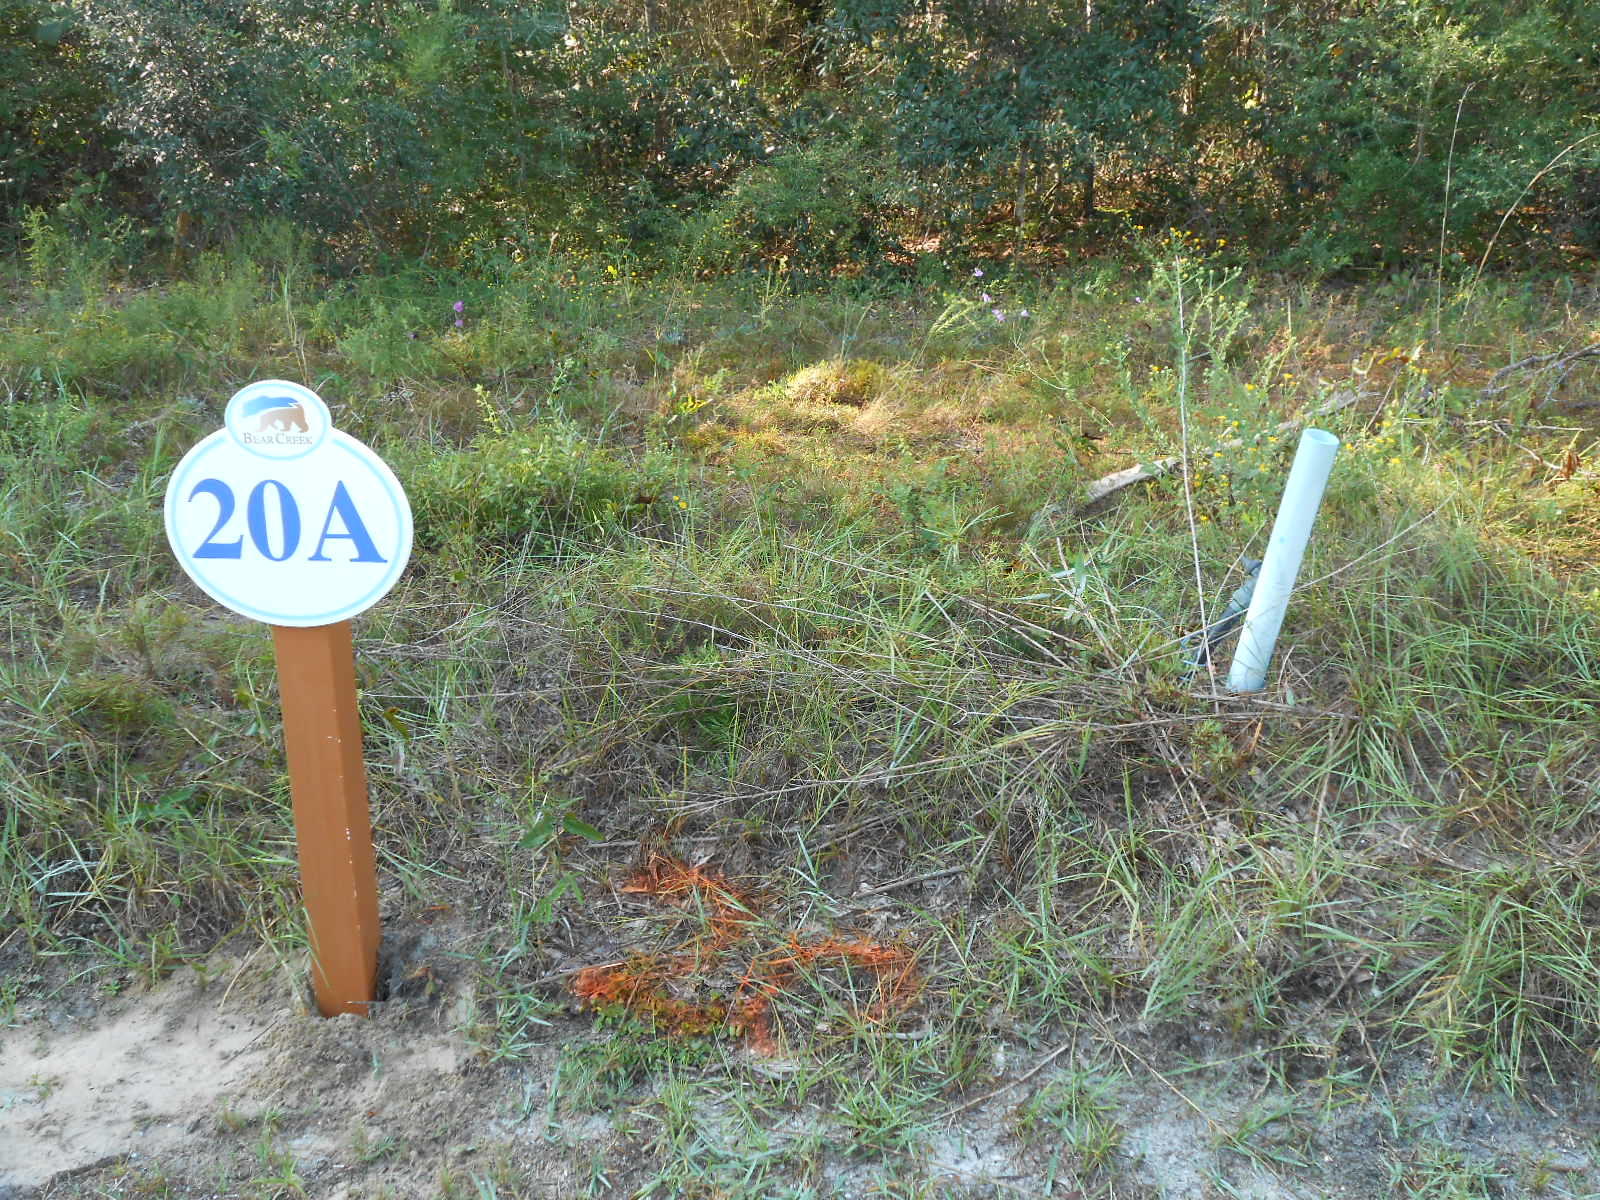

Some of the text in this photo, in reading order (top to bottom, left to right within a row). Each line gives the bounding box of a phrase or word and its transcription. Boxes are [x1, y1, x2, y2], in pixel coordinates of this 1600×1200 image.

[243, 431, 313, 445] BEAR CREEK
[187, 477, 388, 563] 20A
